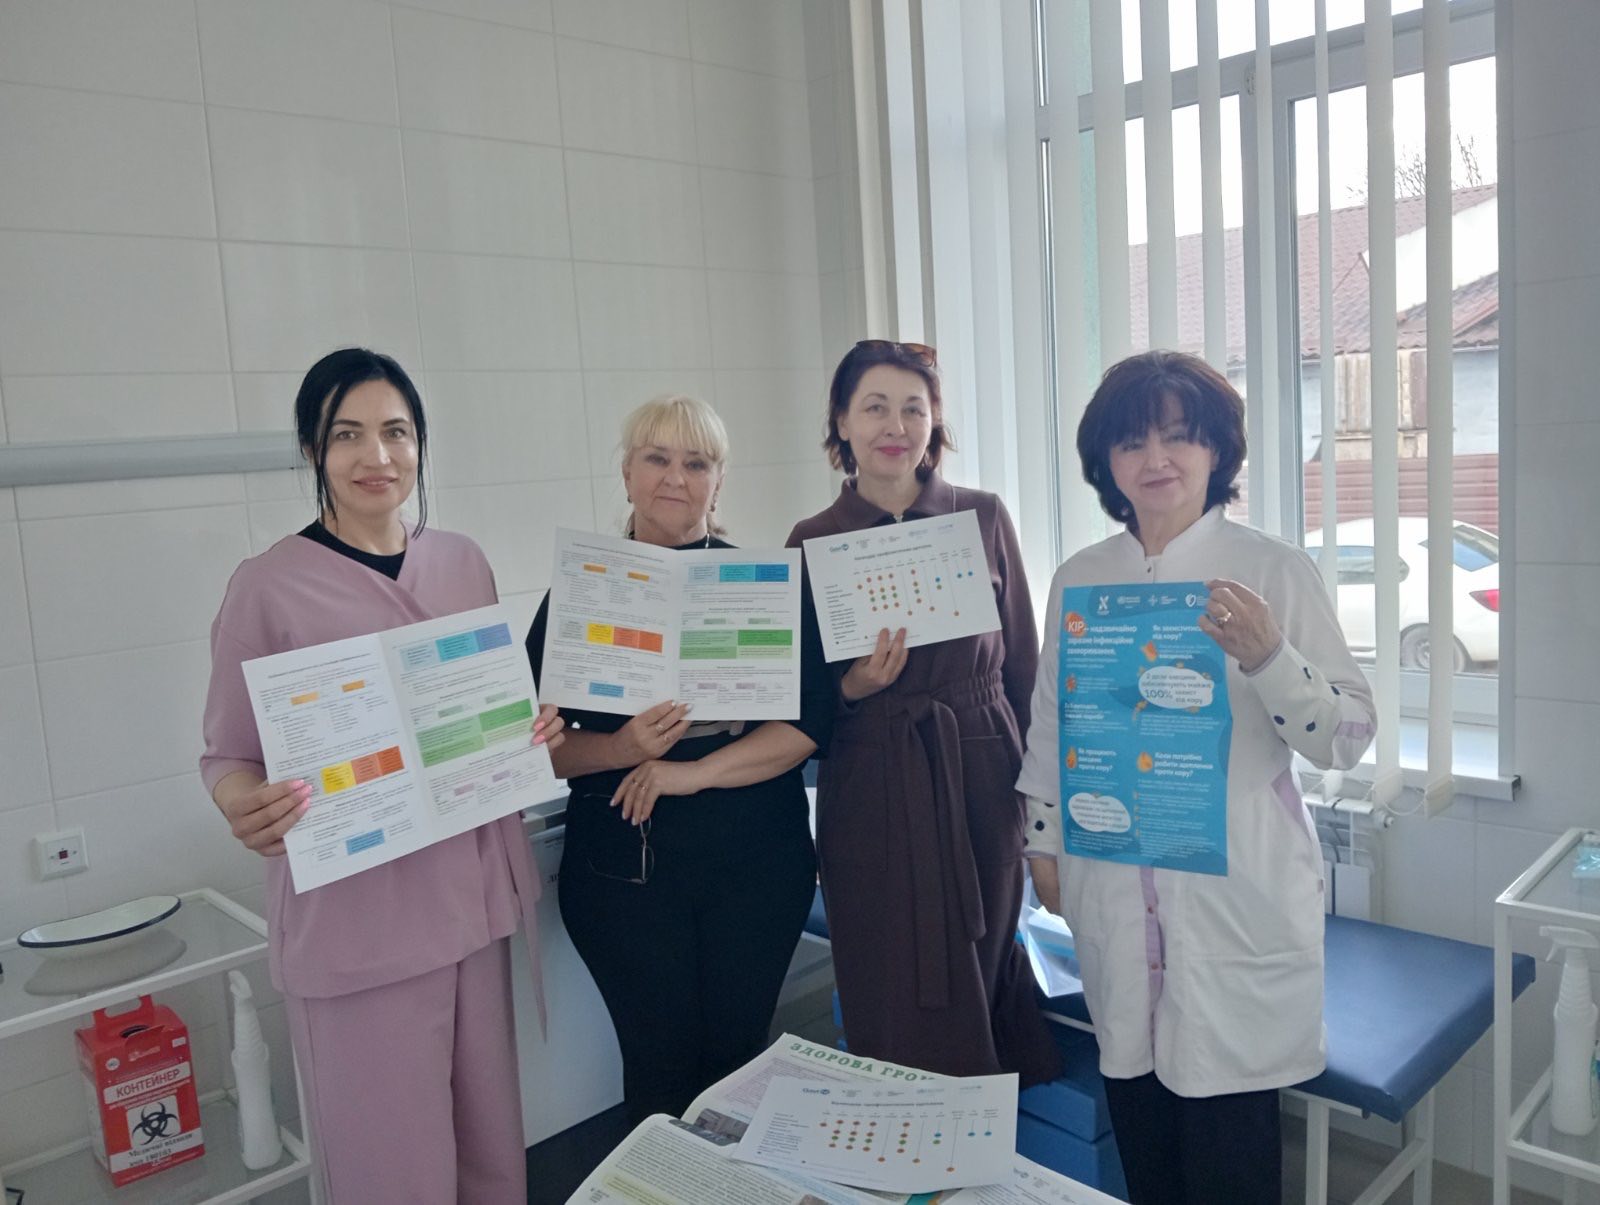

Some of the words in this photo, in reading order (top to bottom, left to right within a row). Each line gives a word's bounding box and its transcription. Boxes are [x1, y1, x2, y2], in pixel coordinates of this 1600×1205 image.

[1067, 621, 1084, 632] КІР
[1145, 689, 1173, 699] 100%
[790, 1042, 874, 1073] ЗДОРОВА
[116, 1068, 180, 1097] КОНТЕЙНЕР
